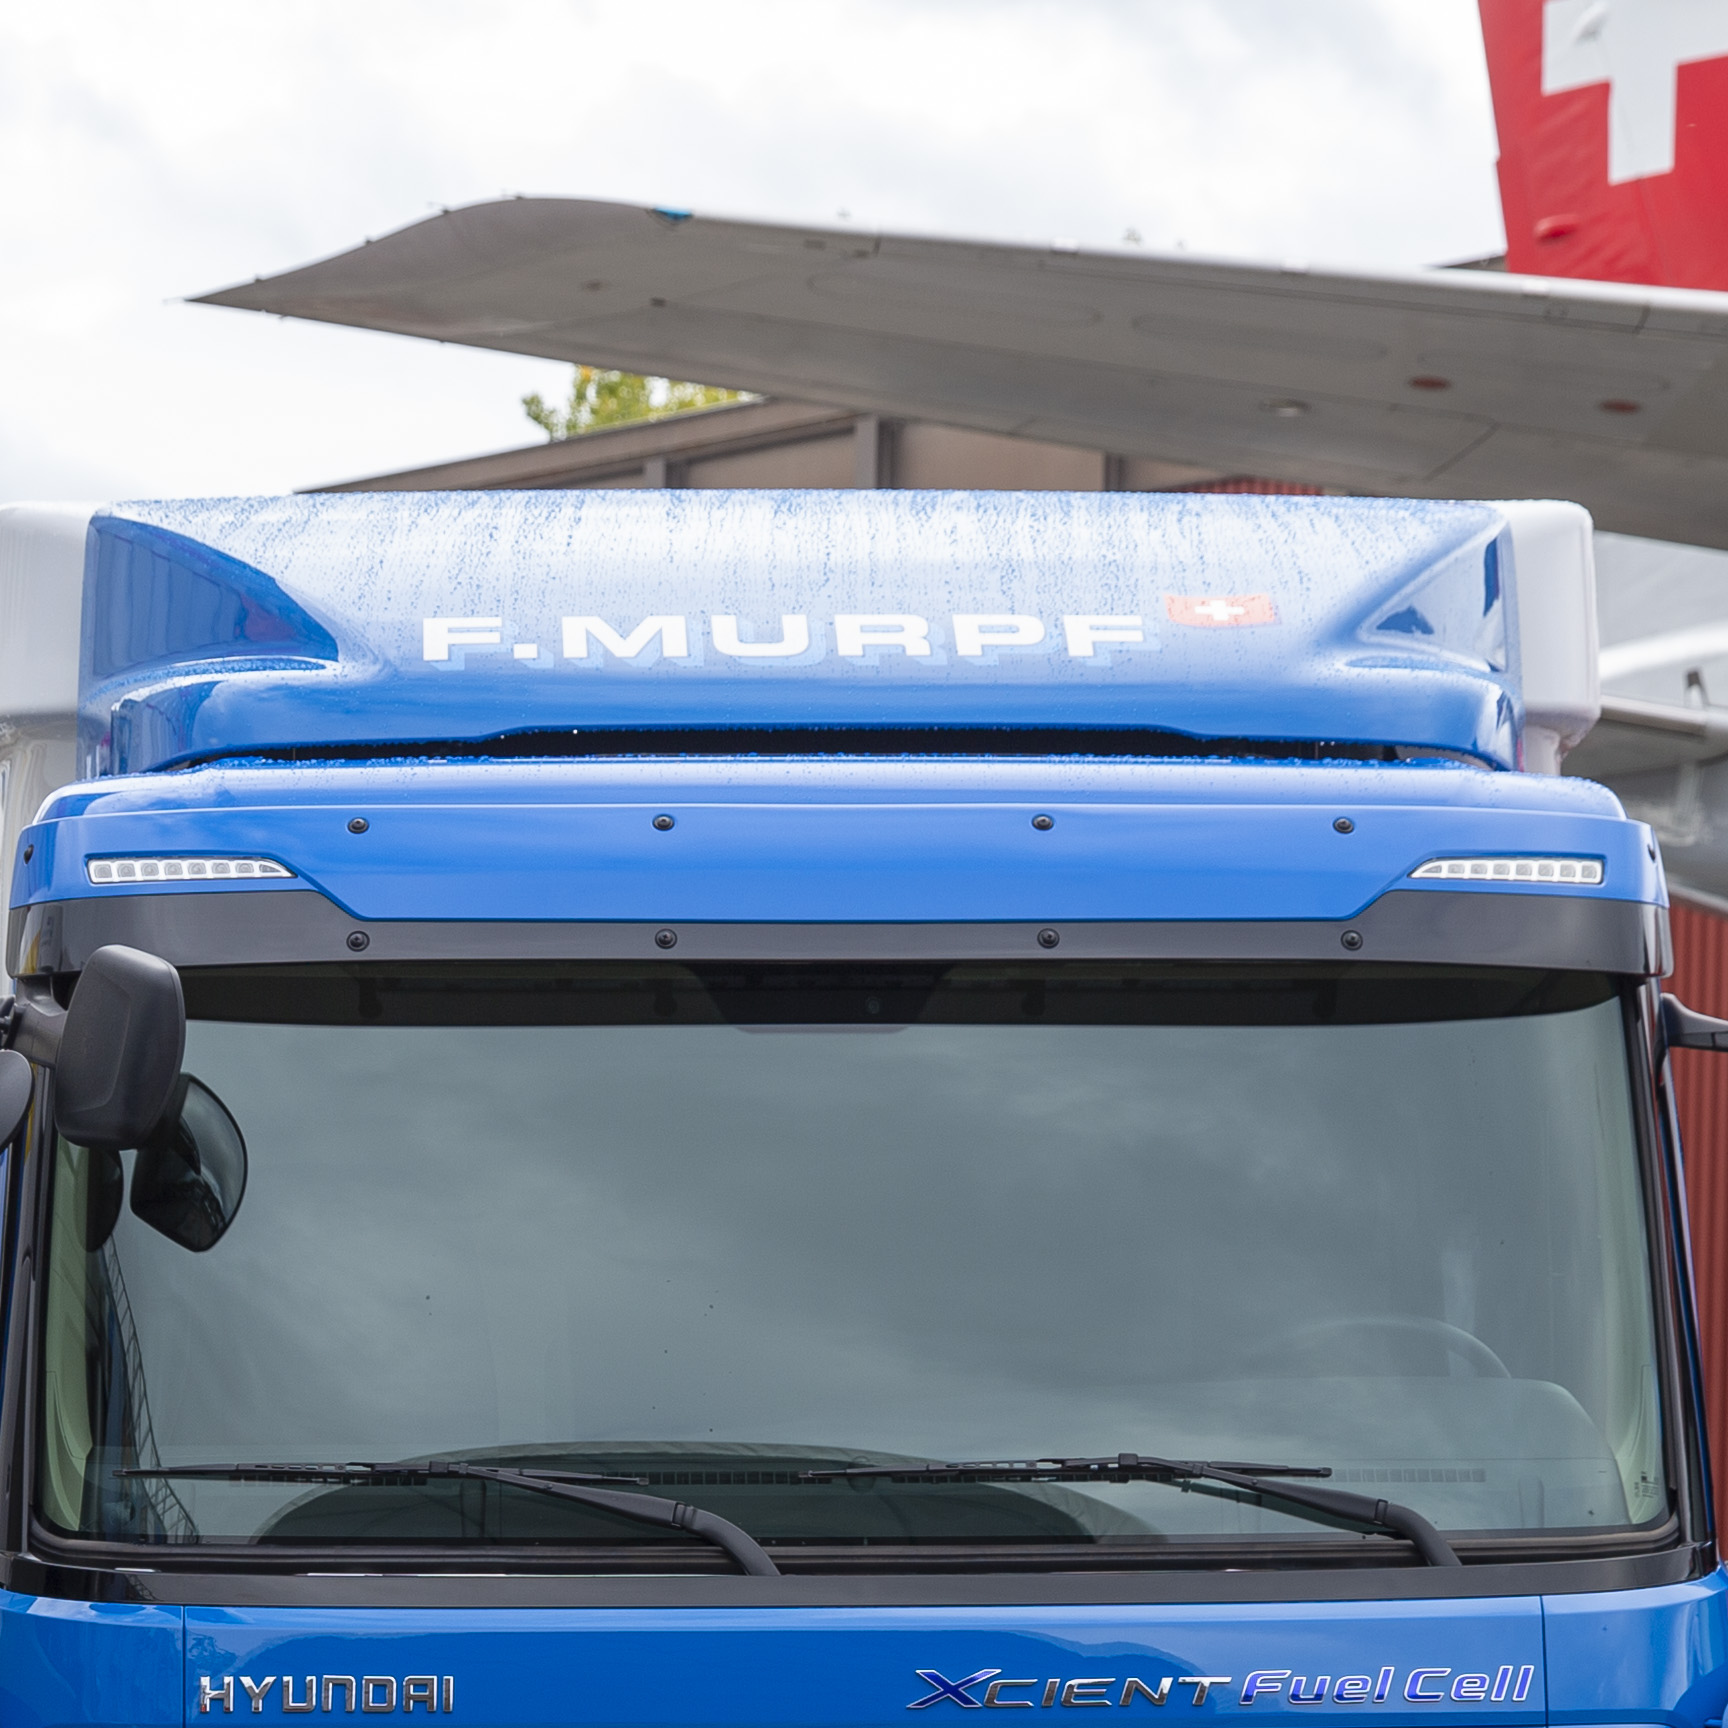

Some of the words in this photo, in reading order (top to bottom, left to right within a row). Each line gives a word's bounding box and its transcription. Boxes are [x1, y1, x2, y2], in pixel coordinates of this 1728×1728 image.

[421, 611, 1147, 664] F.MURPF
[199, 1674, 455, 1714] HYUNDAI
[906, 1667, 1233, 1710] XCIENT
[1238, 1666, 1396, 1706] Fuel
[1402, 1664, 1536, 1703] Cell
